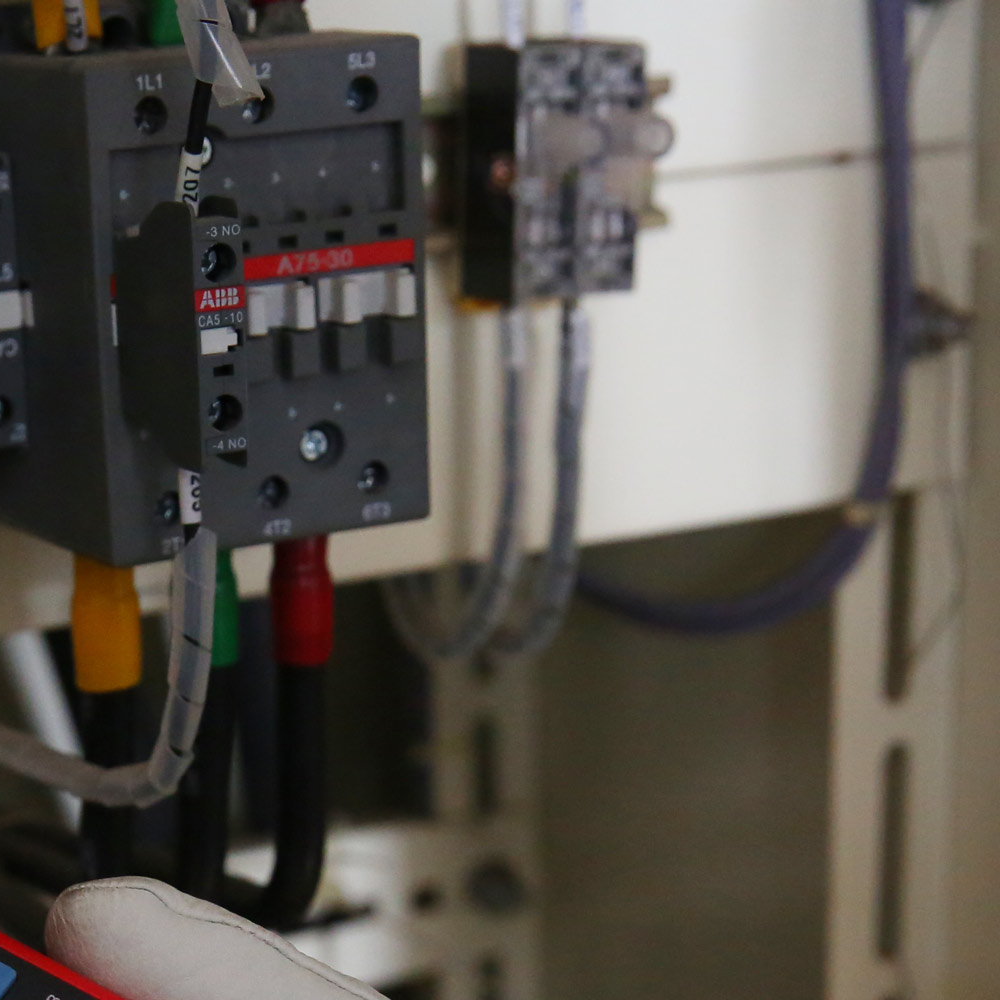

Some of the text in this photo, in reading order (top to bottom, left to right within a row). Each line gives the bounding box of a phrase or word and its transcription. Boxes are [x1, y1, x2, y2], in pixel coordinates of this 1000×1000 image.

[136, 73, 164, 91] 1L1
[182, 166, 200, 203] 207
[205, 224, 241, 238] -3 NO
[276, 248, 355, 276] A75-30
[200, 287, 240, 309] ABB
[197, 316, 221, 328] CA5
[228, 437, 248, 450] NO
